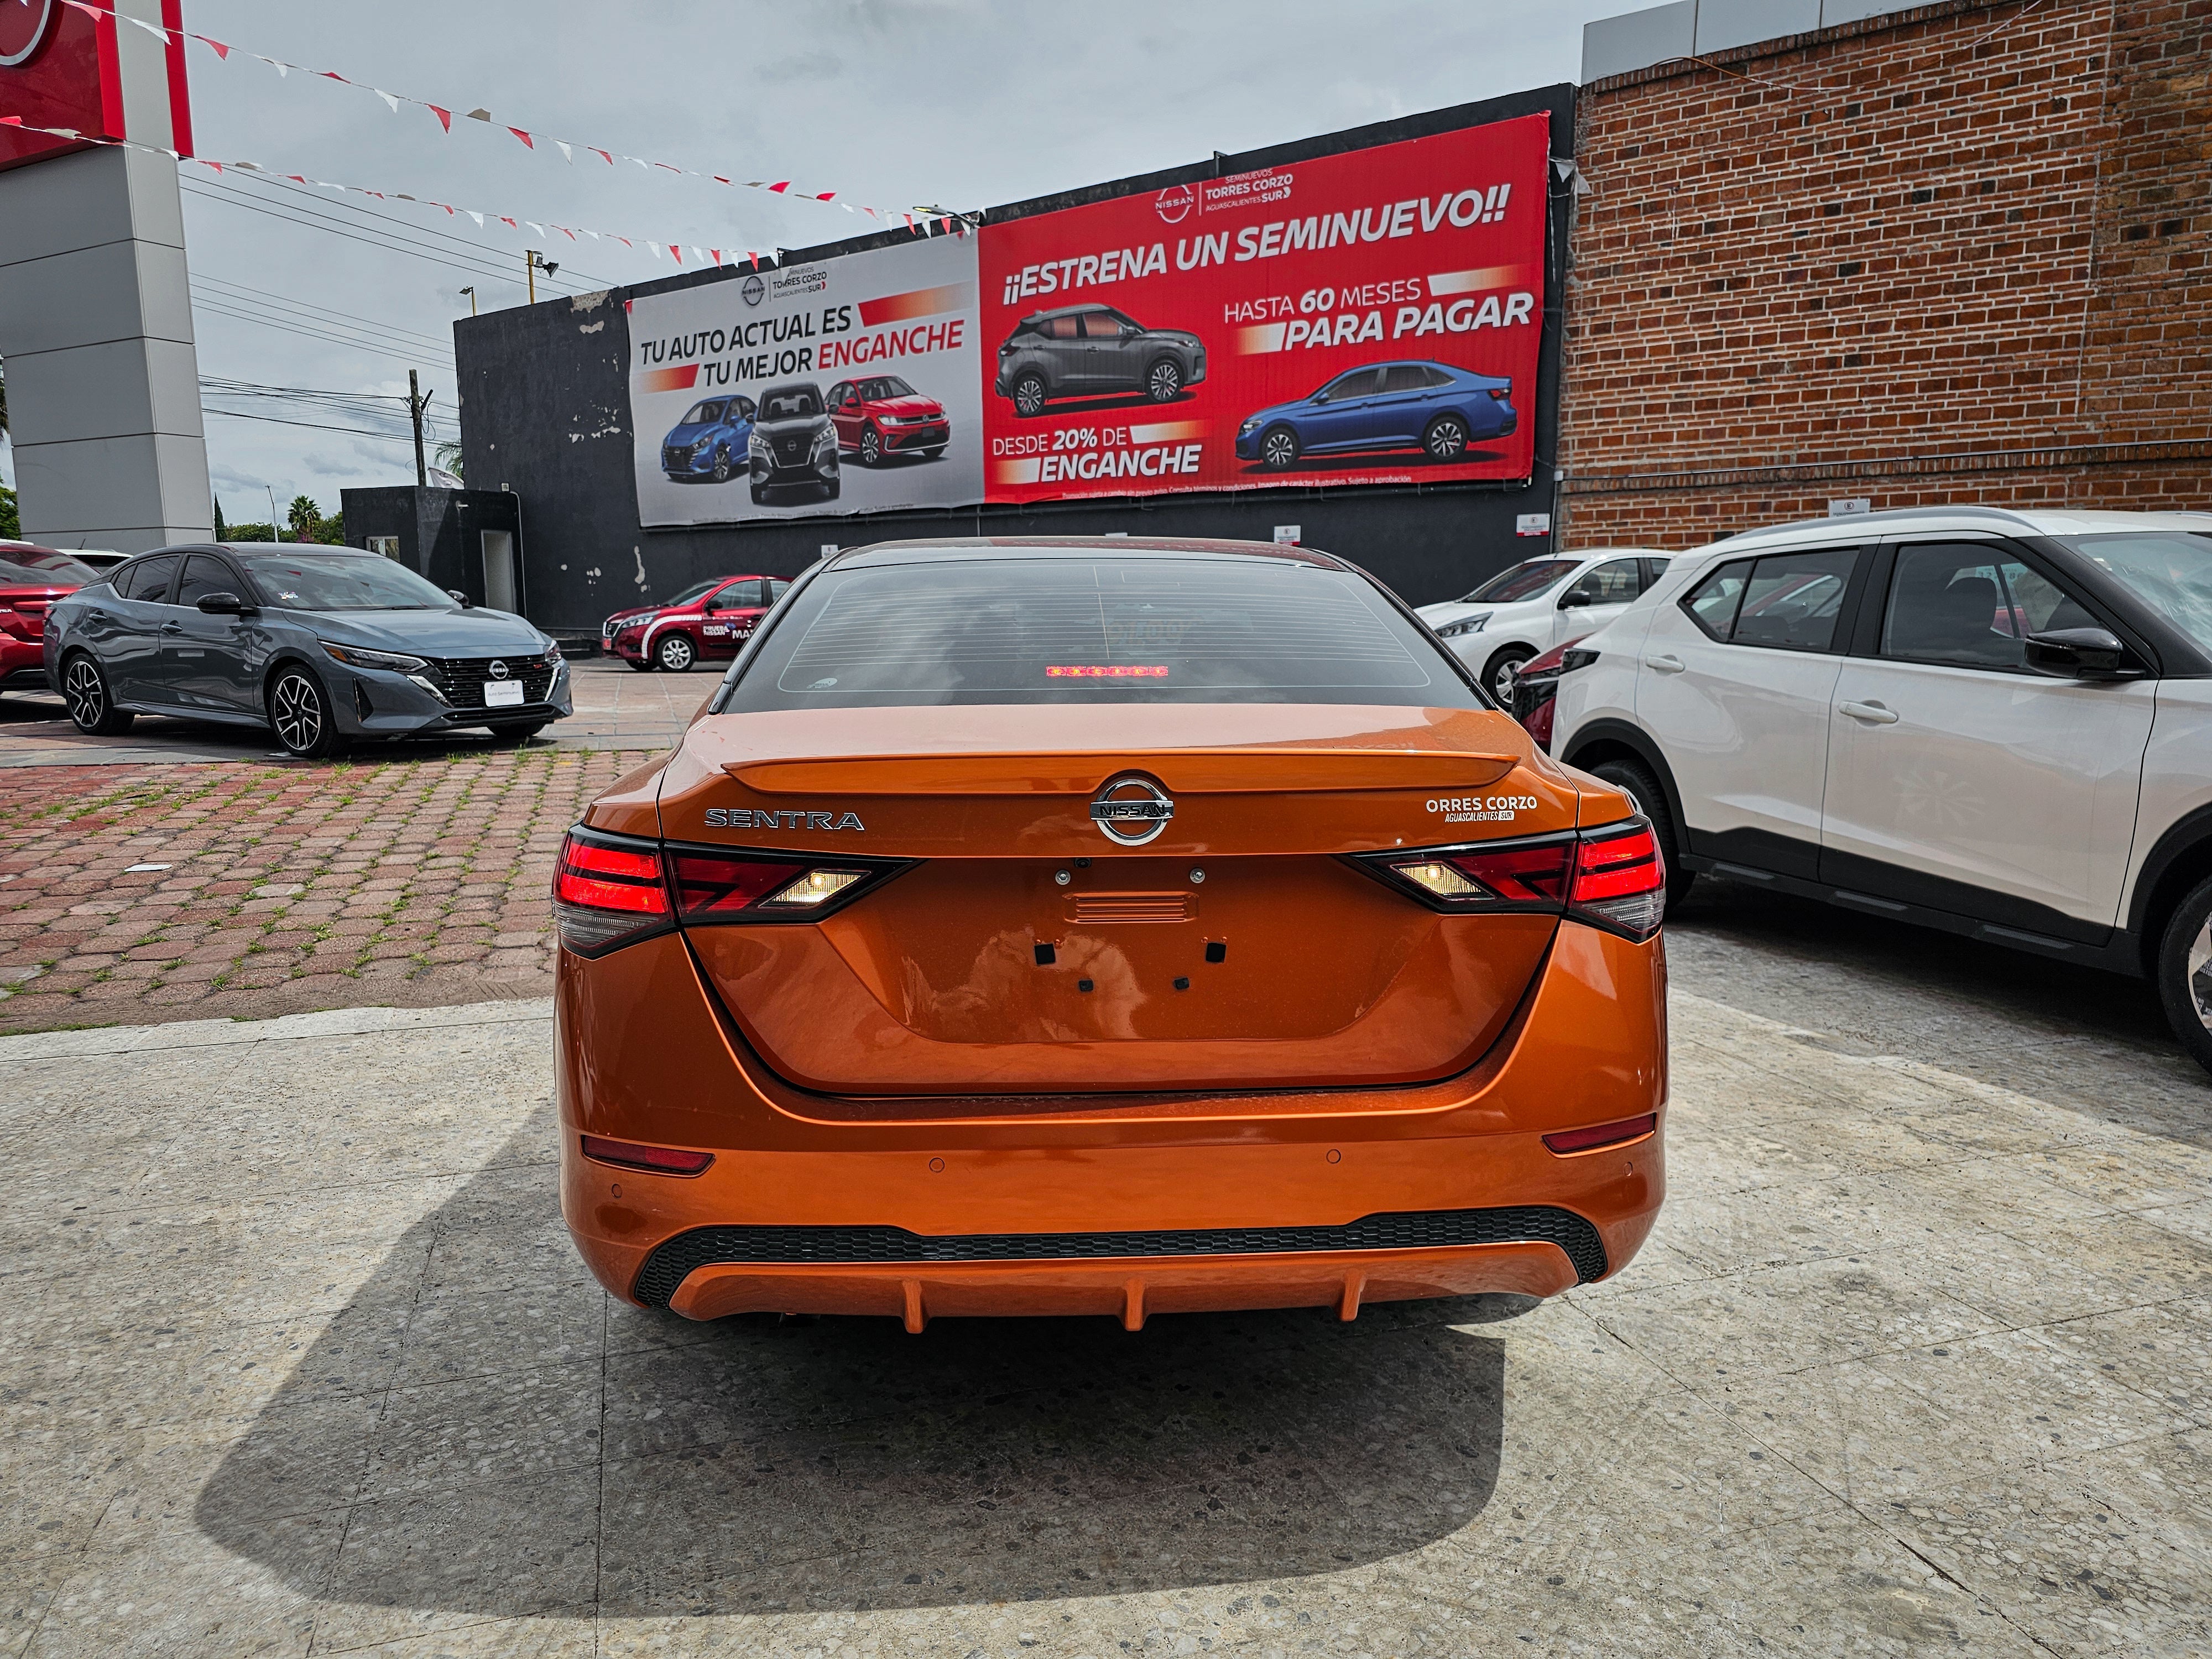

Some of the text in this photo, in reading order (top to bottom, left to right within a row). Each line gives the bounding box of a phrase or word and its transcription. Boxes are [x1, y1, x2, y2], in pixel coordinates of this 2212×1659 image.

[1225, 168, 1273, 184] SEMINUEVOS
[1206, 174, 1293, 200] TORRES CORZO
[1155, 195, 1194, 210] NISSAN
[1206, 191, 1282, 212] AGUASCALIENTES SUR
[1003, 183, 1511, 305] ¡¡ESTRENA UN SEMINUEVO!!
[801, 272, 827, 284] CORZO
[808, 284, 822, 293] SUR
[742, 286, 765, 295] NISSAN
[1225, 278, 1422, 323] HASTA 60 MESES
[1285, 293, 1535, 351] PARA PAGAR
[641, 305, 852, 365] TU AUTO ACTUAL ES
[703, 319, 965, 387] TU MEJOR ENGANCHE
[993, 427, 1128, 456] DESDE 20% DE
[1041, 444, 1202, 482] ENGANCHE
[1348, 476, 1369, 486] Sujeto
[1099, 804, 1166, 817] NISSAN
[1426, 796, 1538, 813] ORRES CORZO
[704, 808, 865, 831] SENTRA
[1444, 811, 1512, 823] AGUASCALIENTES SUR
